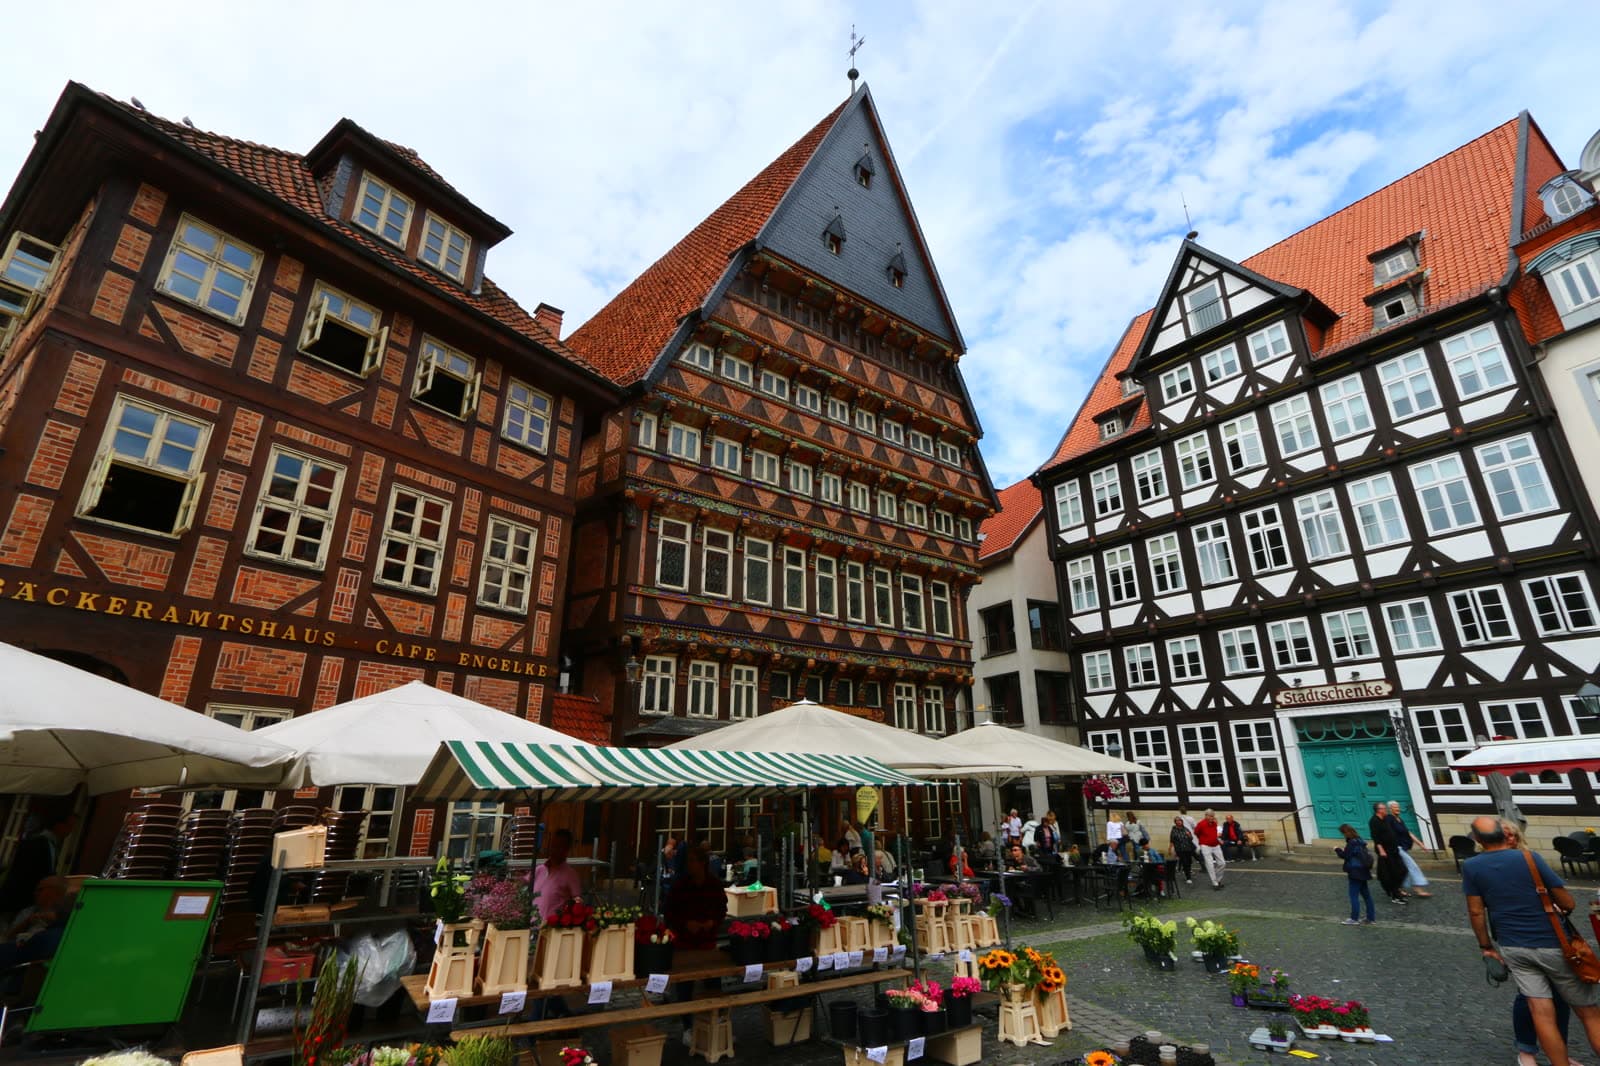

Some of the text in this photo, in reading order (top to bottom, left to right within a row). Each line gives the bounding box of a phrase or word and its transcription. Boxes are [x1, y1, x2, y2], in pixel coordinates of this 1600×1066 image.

[0, 579, 548, 677] ÄCKERAMTSHAUS CAFE ENGELKE
[1284, 683, 1383, 704] Stadtschenke
